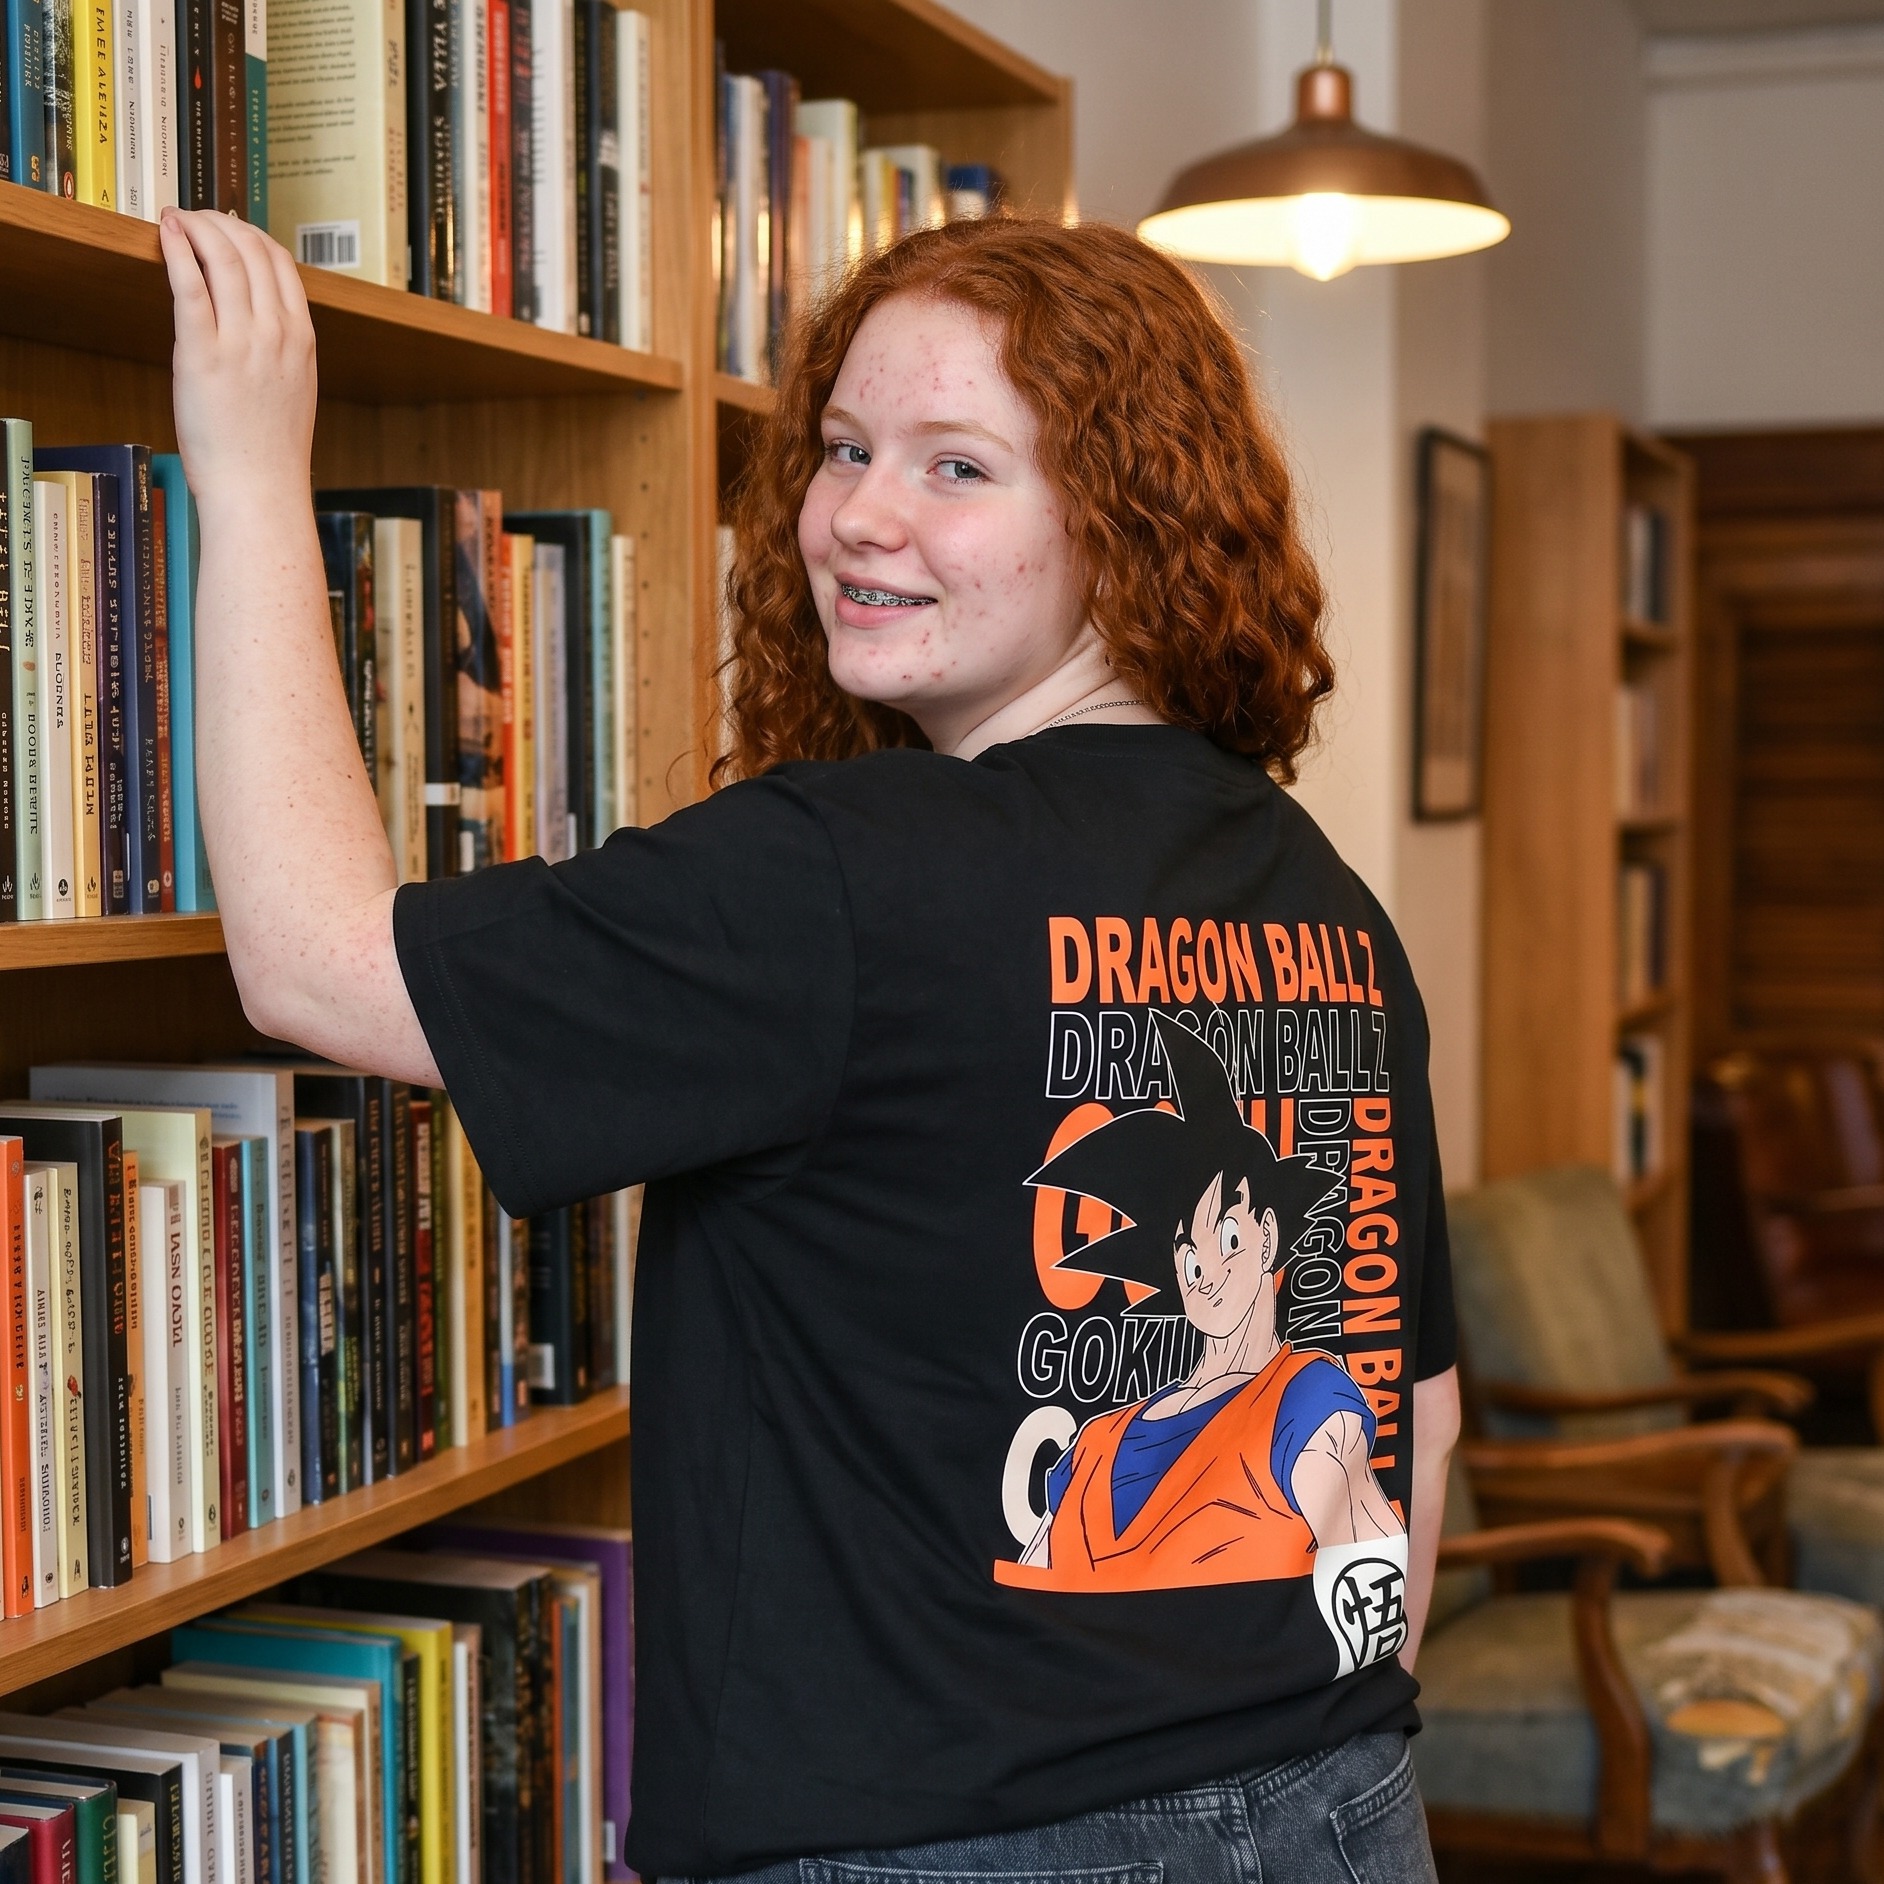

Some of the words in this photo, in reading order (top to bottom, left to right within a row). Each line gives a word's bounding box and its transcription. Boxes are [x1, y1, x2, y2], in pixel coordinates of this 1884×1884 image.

[1048, 916, 1263, 1004] DRAGON
[1045, 1009, 1265, 1100] DRAON
[1342, 1097, 1401, 1335] DRAGON
